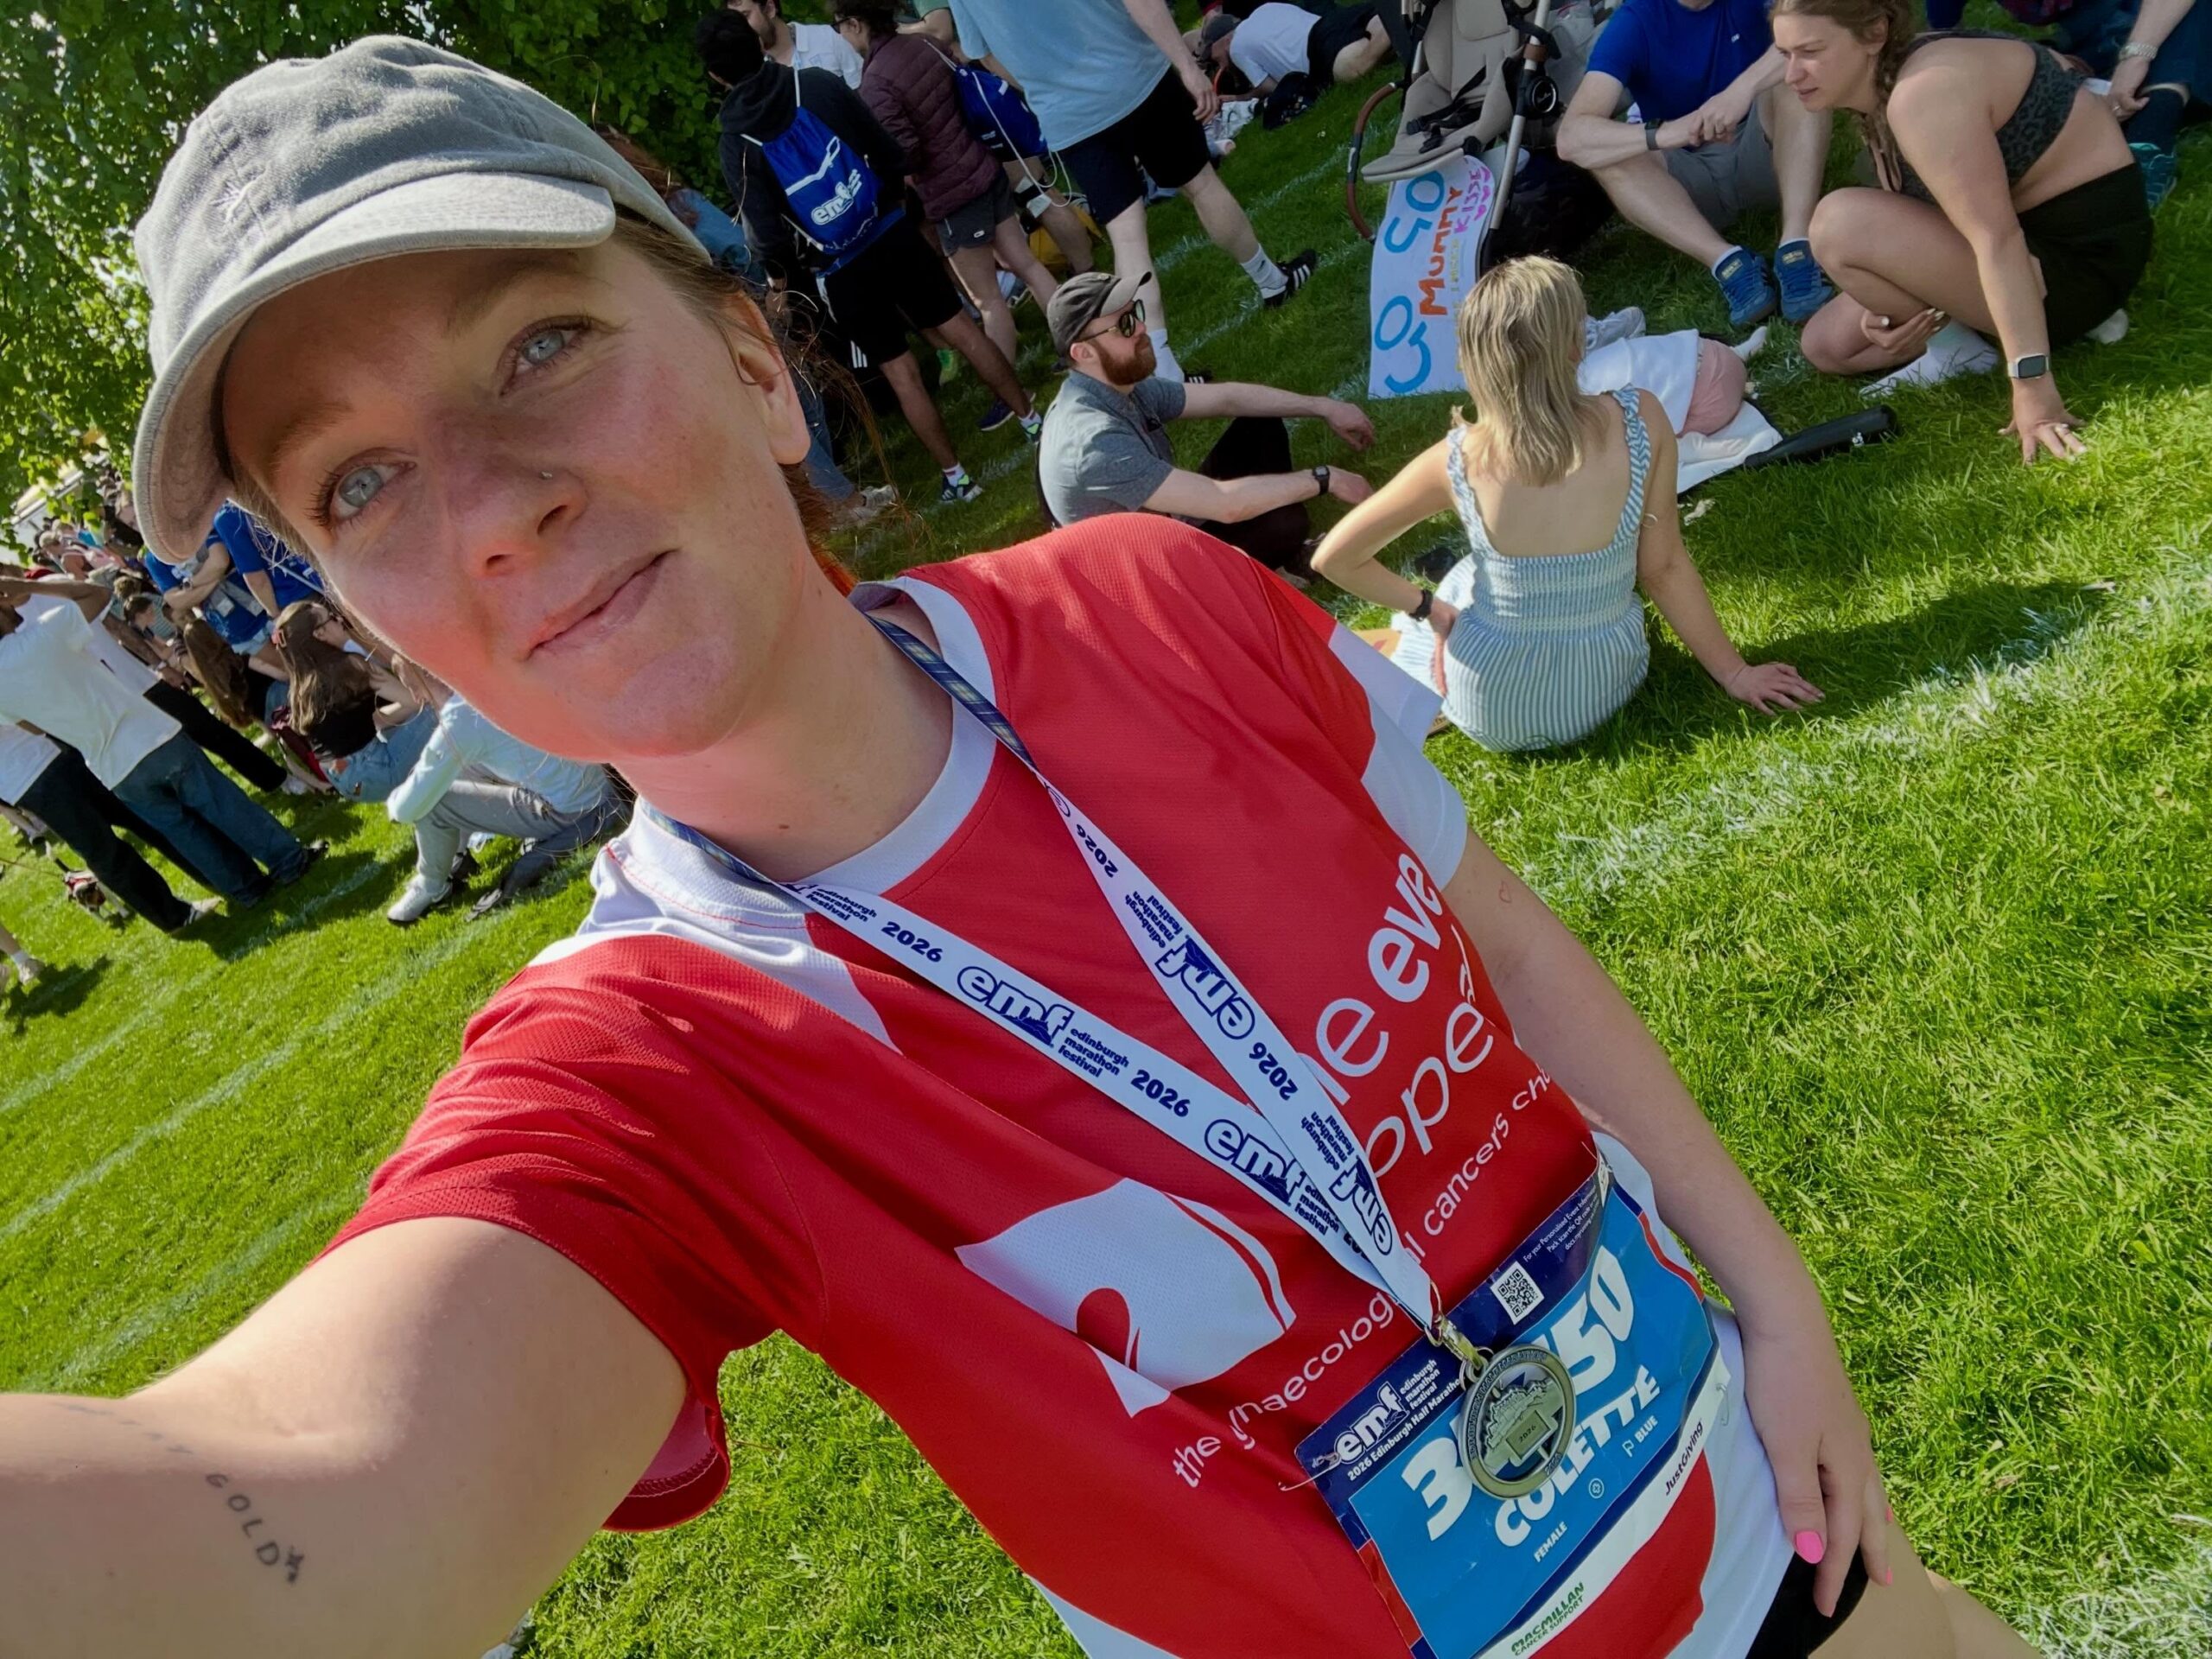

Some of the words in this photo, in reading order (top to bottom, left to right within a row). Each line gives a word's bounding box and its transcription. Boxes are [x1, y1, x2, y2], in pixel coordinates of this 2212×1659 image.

[1384, 170, 1444, 253] GO
[1375, 296, 1431, 393] GO
[1076, 823, 1118, 878] 2026
[805, 893, 851, 921] festival
[811, 891, 868, 922] marathon
[817, 888, 877, 918] edinburgh
[1124, 894, 1166, 949] edinburgh
[1133, 891, 1174, 942] marathon
[1147, 894, 1184, 936] festival
[880, 921, 944, 963] 2026
[957, 966, 1075, 1046] emf
[1154, 940, 1255, 1040] emf
[1058, 1045, 1103, 1077] festival
[1064, 1036, 1121, 1076] marathon
[1071, 1027, 1128, 1068] edinburgh
[1249, 1041, 1298, 1101] 2026
[1130, 1069, 1191, 1118] 2026
[1300, 1116, 1340, 1172] edinburgh
[1311, 1111, 1348, 1164] marathon
[1325, 1115, 1355, 1155] festival
[1205, 1119, 1306, 1205] emf
[1294, 1202, 1329, 1236] festival
[1299, 1194, 1339, 1233] marathon
[1328, 1158, 1393, 1255] emf
[1522, 1252, 1533, 1262] For
[1540, 1217, 1568, 1245] Personalised
[1173, 1435, 1221, 1488] the
[1423, 1112, 1510, 1236] cancers
[1400, 1358, 1437, 1395] edinburgh
[1402, 1245, 1634, 1541] 350
[1405, 1368, 1440, 1402] marathon
[1409, 1382, 1438, 1410] festival
[1334, 1381, 1410, 1465] emf
[1347, 1458, 1372, 1481] 2026
[1370, 1423, 1413, 1463] Edinburgh
[1411, 1405, 1430, 1426] Half
[1427, 1376, 1462, 1411] Maratho
[1518, 1425, 1537, 1443] 2026
[1635, 1415, 1659, 1444] BLUE
[1495, 1364, 1661, 1547] COLETTE
[1665, 1421, 1704, 1496] JustGiving
[206, 1473, 280, 1566] GOLD
[1534, 1521, 1568, 1563] FEMALE
[1510, 1582, 1585, 1652] MACMILLAN
[1514, 1626, 1550, 1657] CANCER
[1549, 1595, 1585, 1632] SUPPORT
